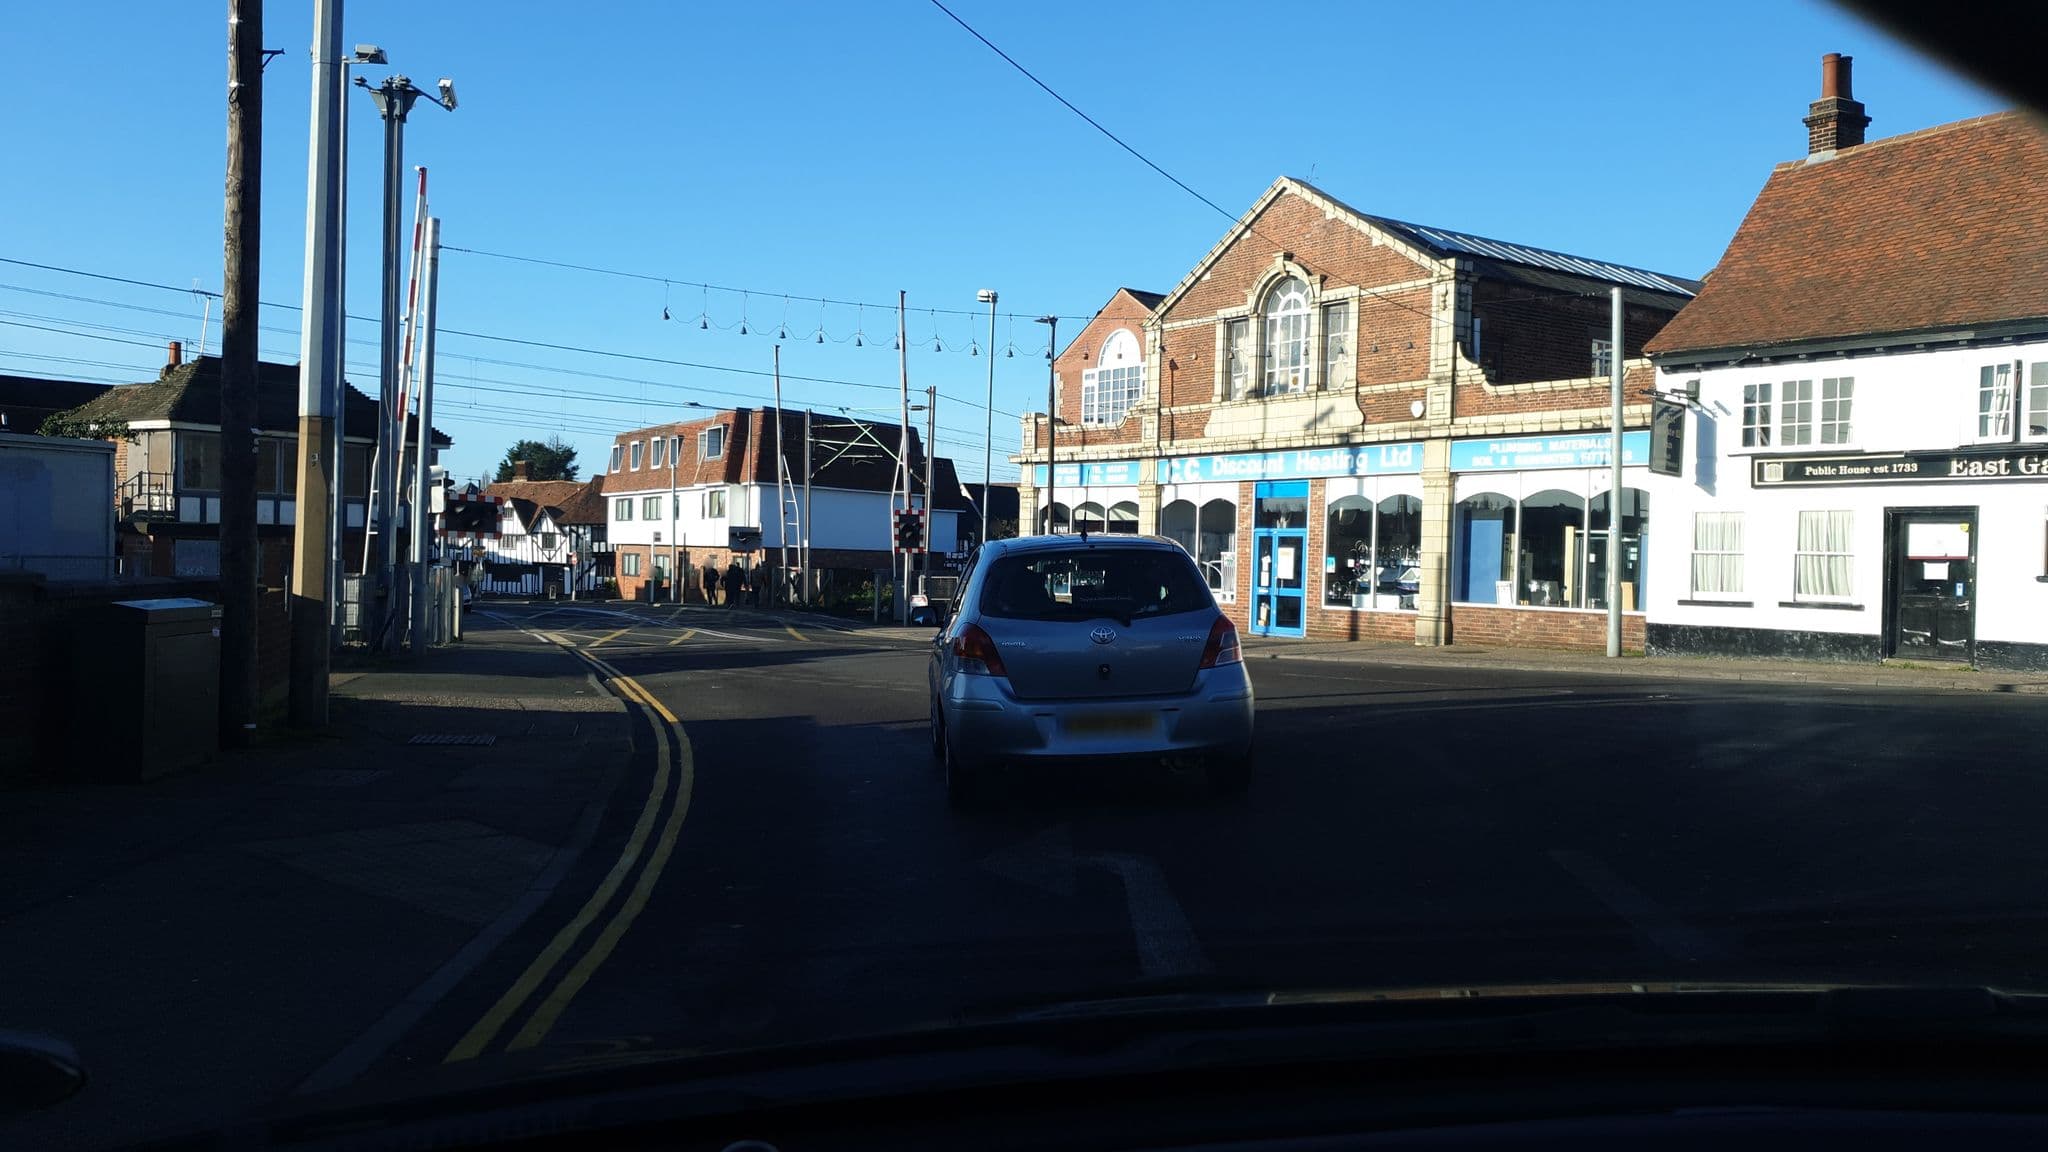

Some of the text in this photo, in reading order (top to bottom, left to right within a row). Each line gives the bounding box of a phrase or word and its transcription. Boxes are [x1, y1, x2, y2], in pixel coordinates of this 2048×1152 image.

[1212, 453, 1284, 475] Discount
[1296, 449, 1369, 474] Heating
[1380, 446, 1413, 467] Ltd
[1805, 463, 1918, 476] Public House est 1733
[1948, 457, 2010, 476] East
